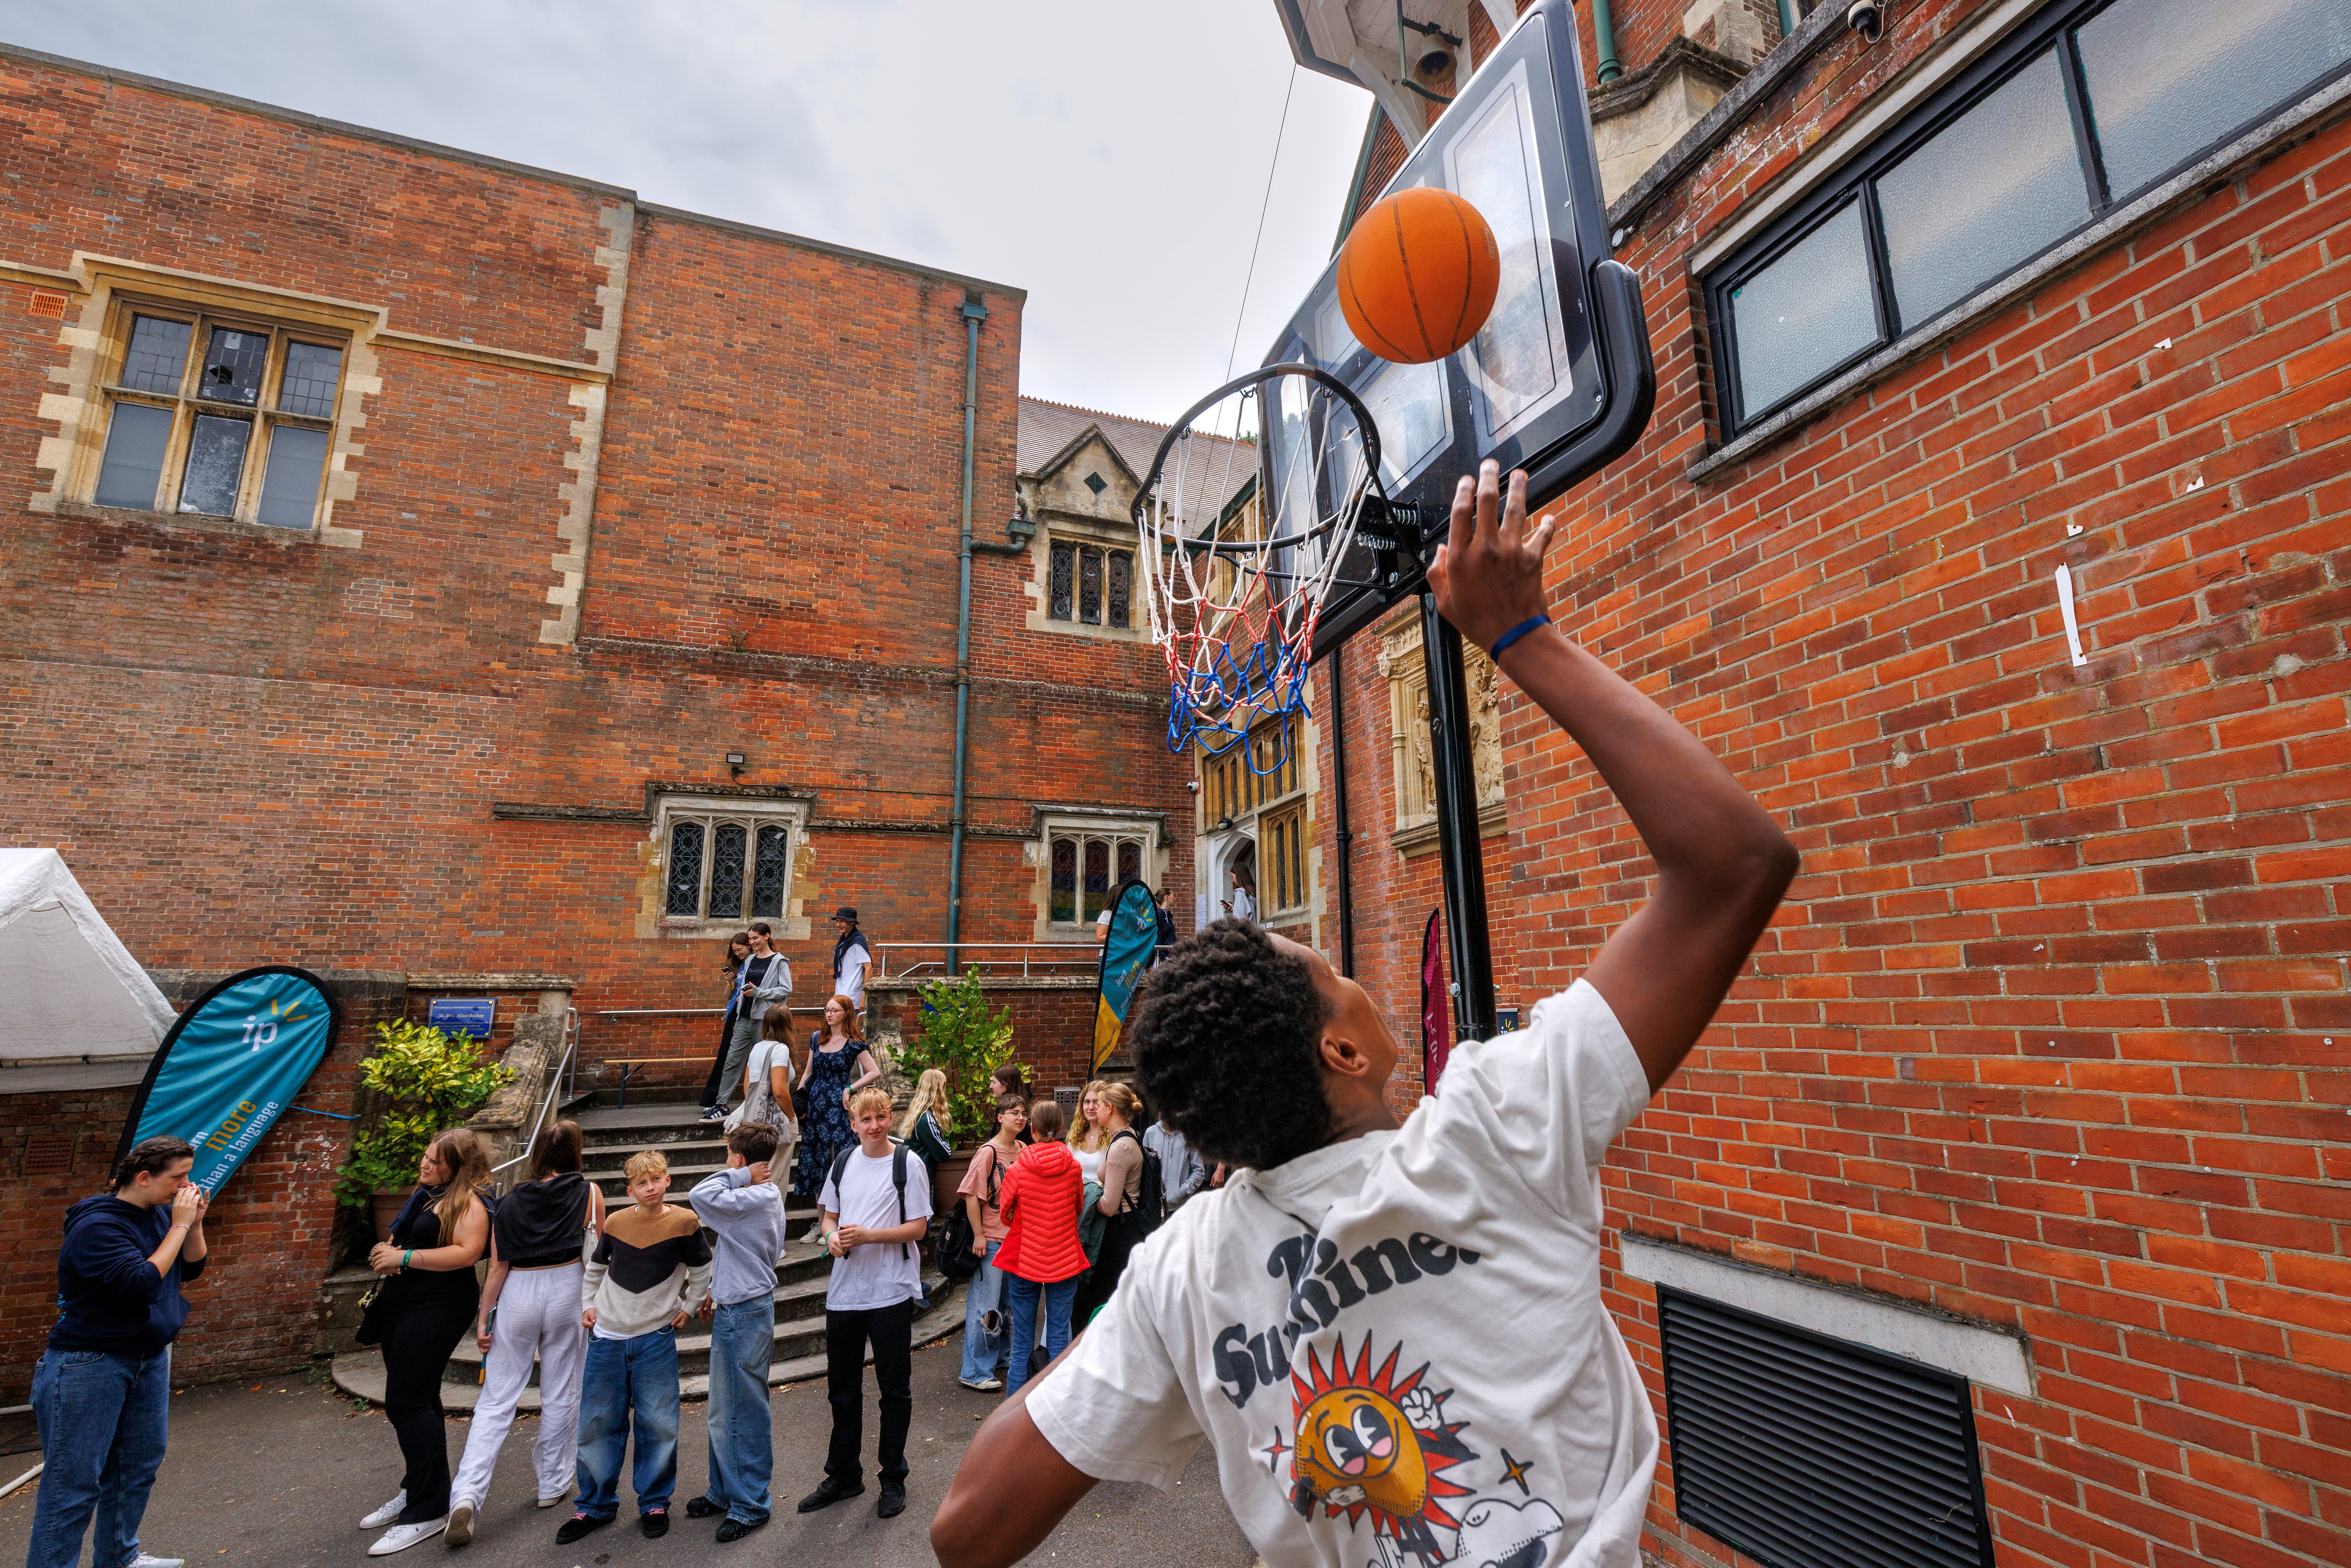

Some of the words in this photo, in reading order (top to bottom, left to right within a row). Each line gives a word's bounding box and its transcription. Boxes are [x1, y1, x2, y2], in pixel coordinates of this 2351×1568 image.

[1115, 970, 1128, 987] learn
[1120, 997, 1129, 1012] than
[1130, 967, 1144, 993] language
[1125, 961, 1141, 988] more
[242, 1015, 277, 1051] ip
[205, 1101, 257, 1151] more
[228, 1101, 279, 1152] language
[224, 1153, 237, 1162] a
[198, 1163, 229, 1190] than
